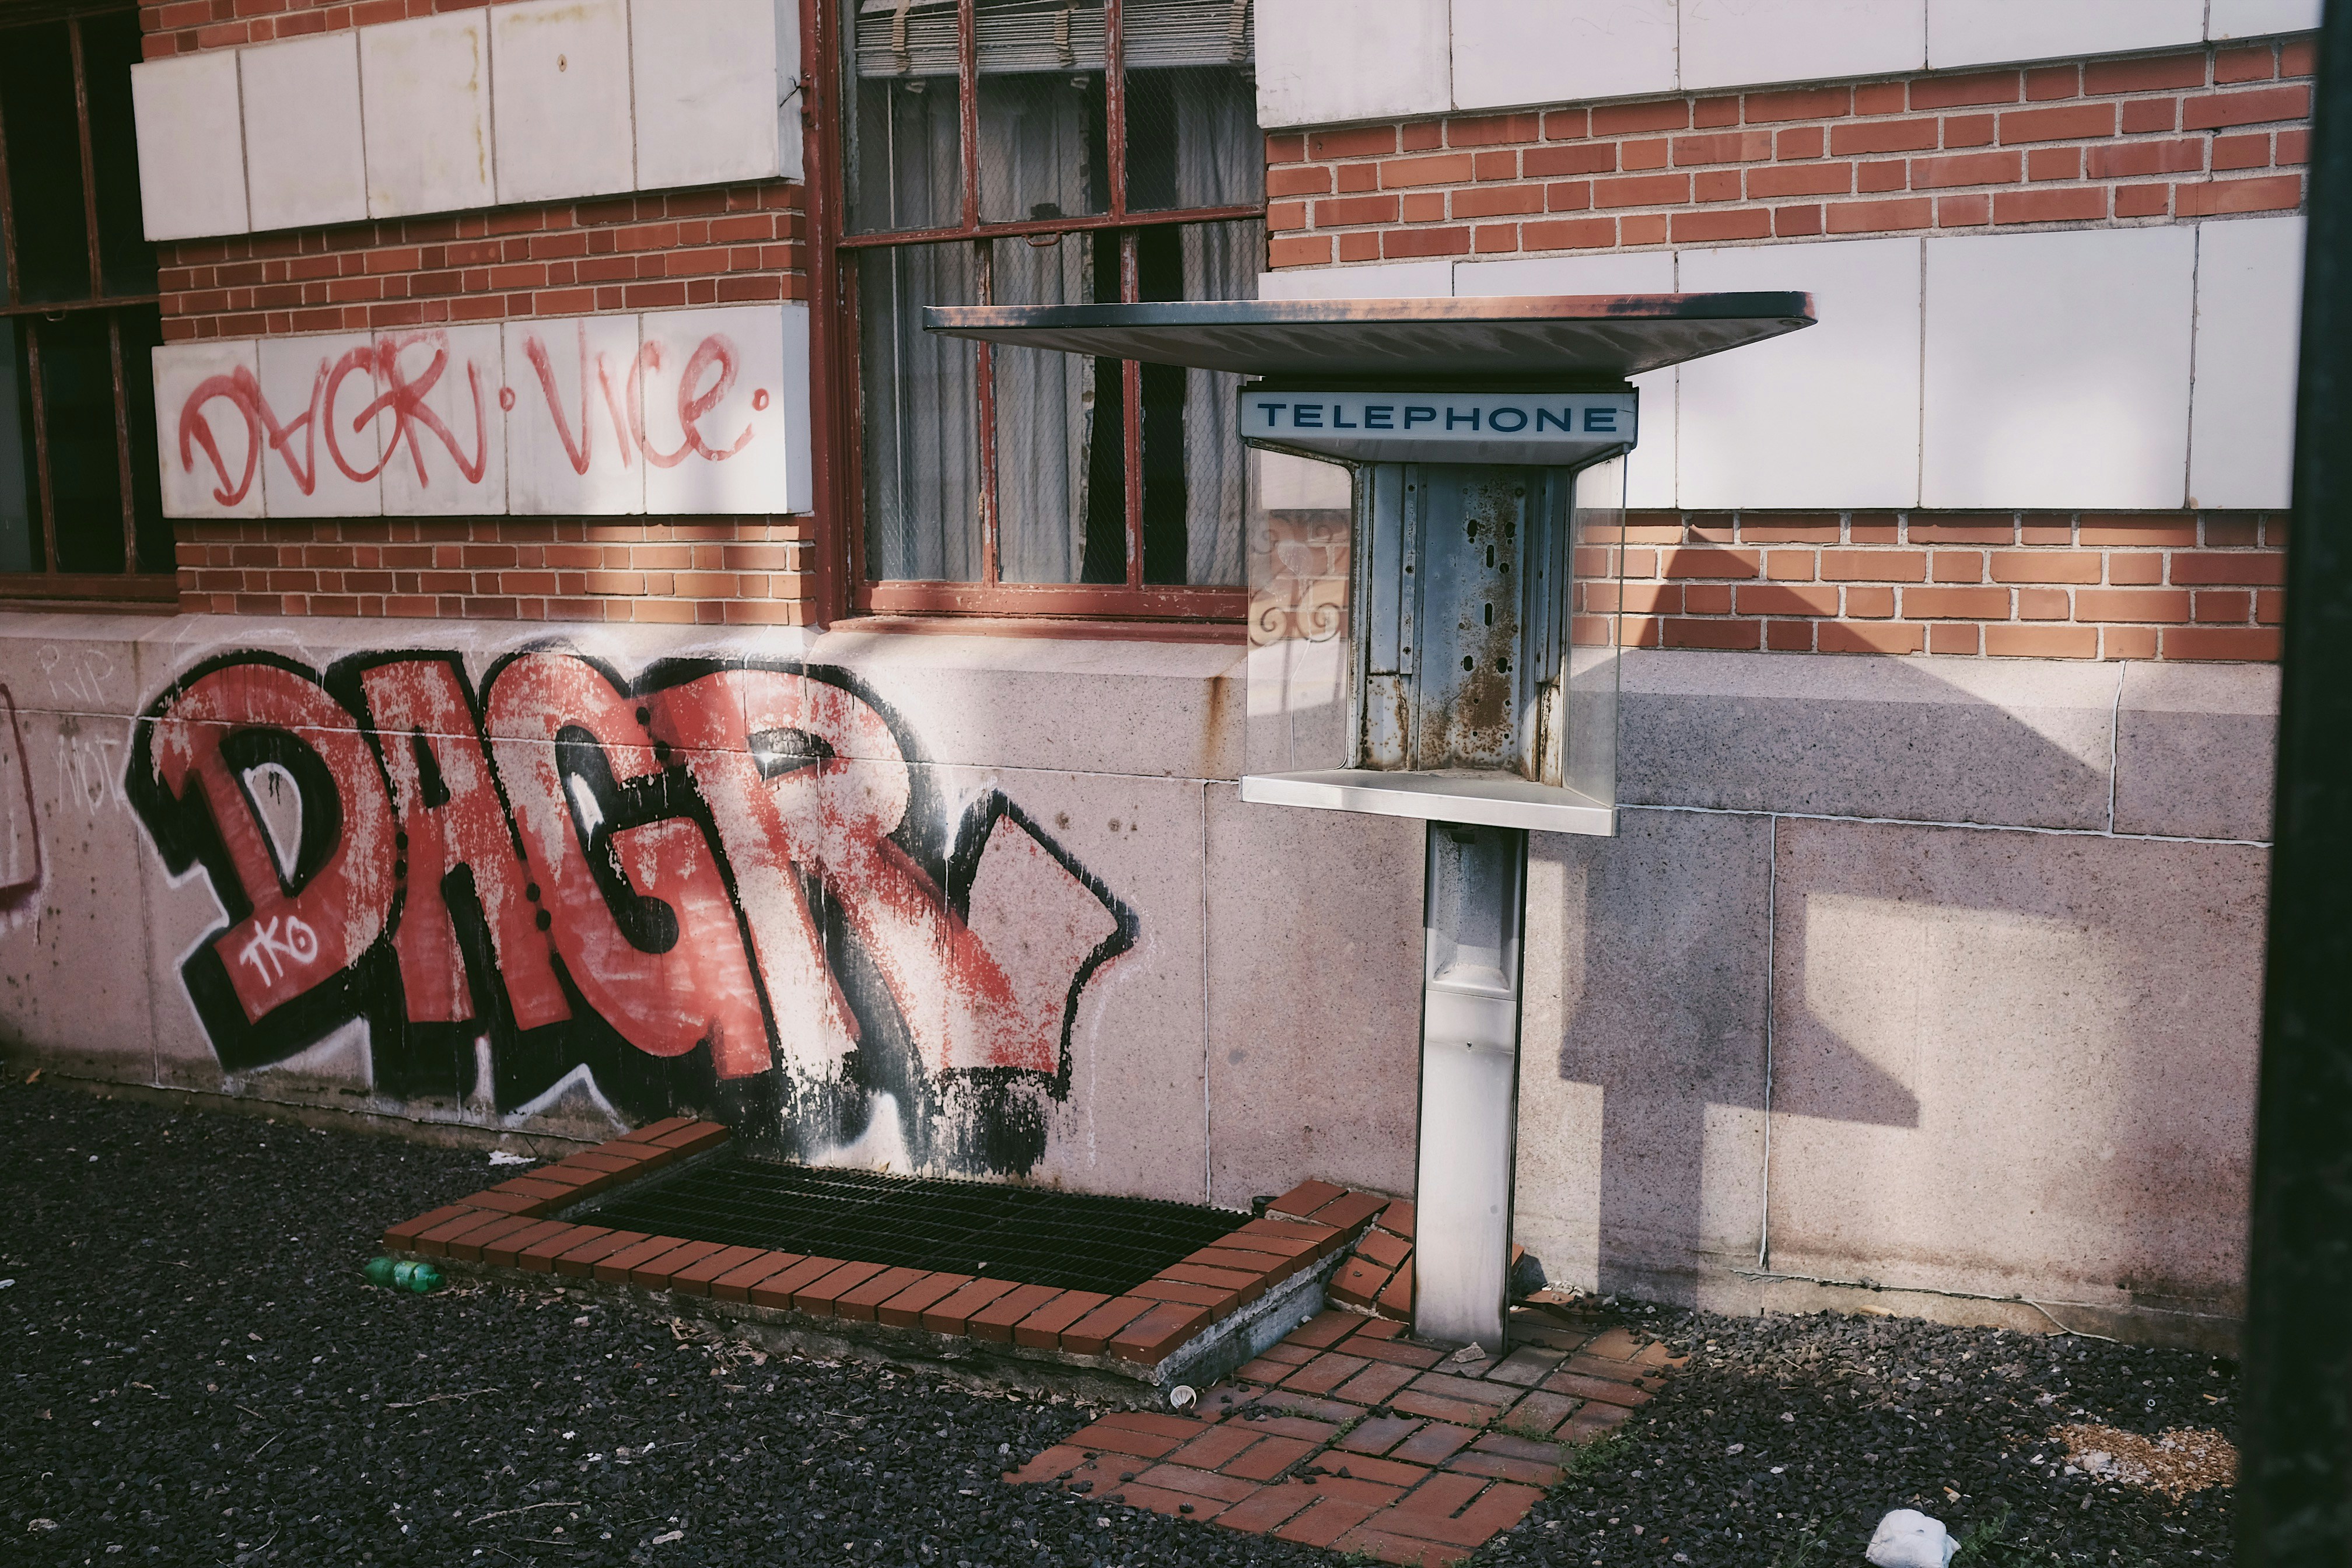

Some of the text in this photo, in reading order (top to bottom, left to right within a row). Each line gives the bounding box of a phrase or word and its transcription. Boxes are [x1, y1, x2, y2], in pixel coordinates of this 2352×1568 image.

[1257, 402, 1618, 433] TELEPHONE
[36, 643, 114, 707] RIP
[131, 639, 1126, 1143] DAGR
[239, 915, 318, 988] TKO
